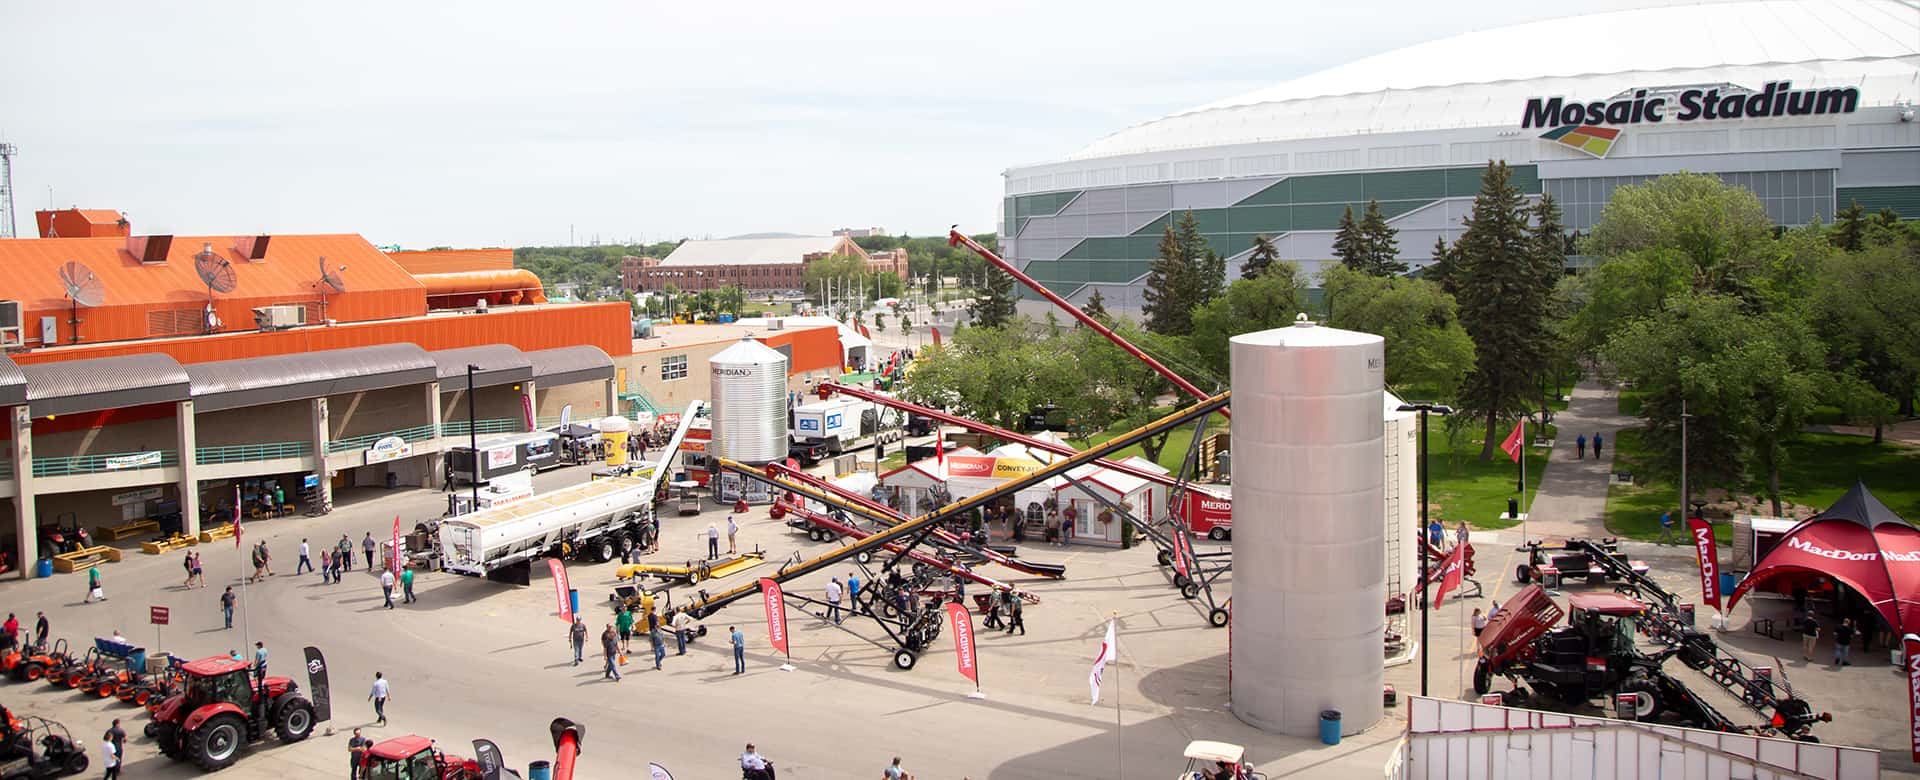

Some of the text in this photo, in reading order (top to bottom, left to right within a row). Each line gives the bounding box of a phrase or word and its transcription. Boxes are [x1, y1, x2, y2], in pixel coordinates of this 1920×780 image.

[1522, 81, 1859, 129] Mosaic Stadium
[712, 367, 746, 376] MERIDIAN
[950, 462, 983, 471] MERIDIAN
[1788, 536, 1879, 561] MacDon
[1695, 527, 1714, 599] MacDon
